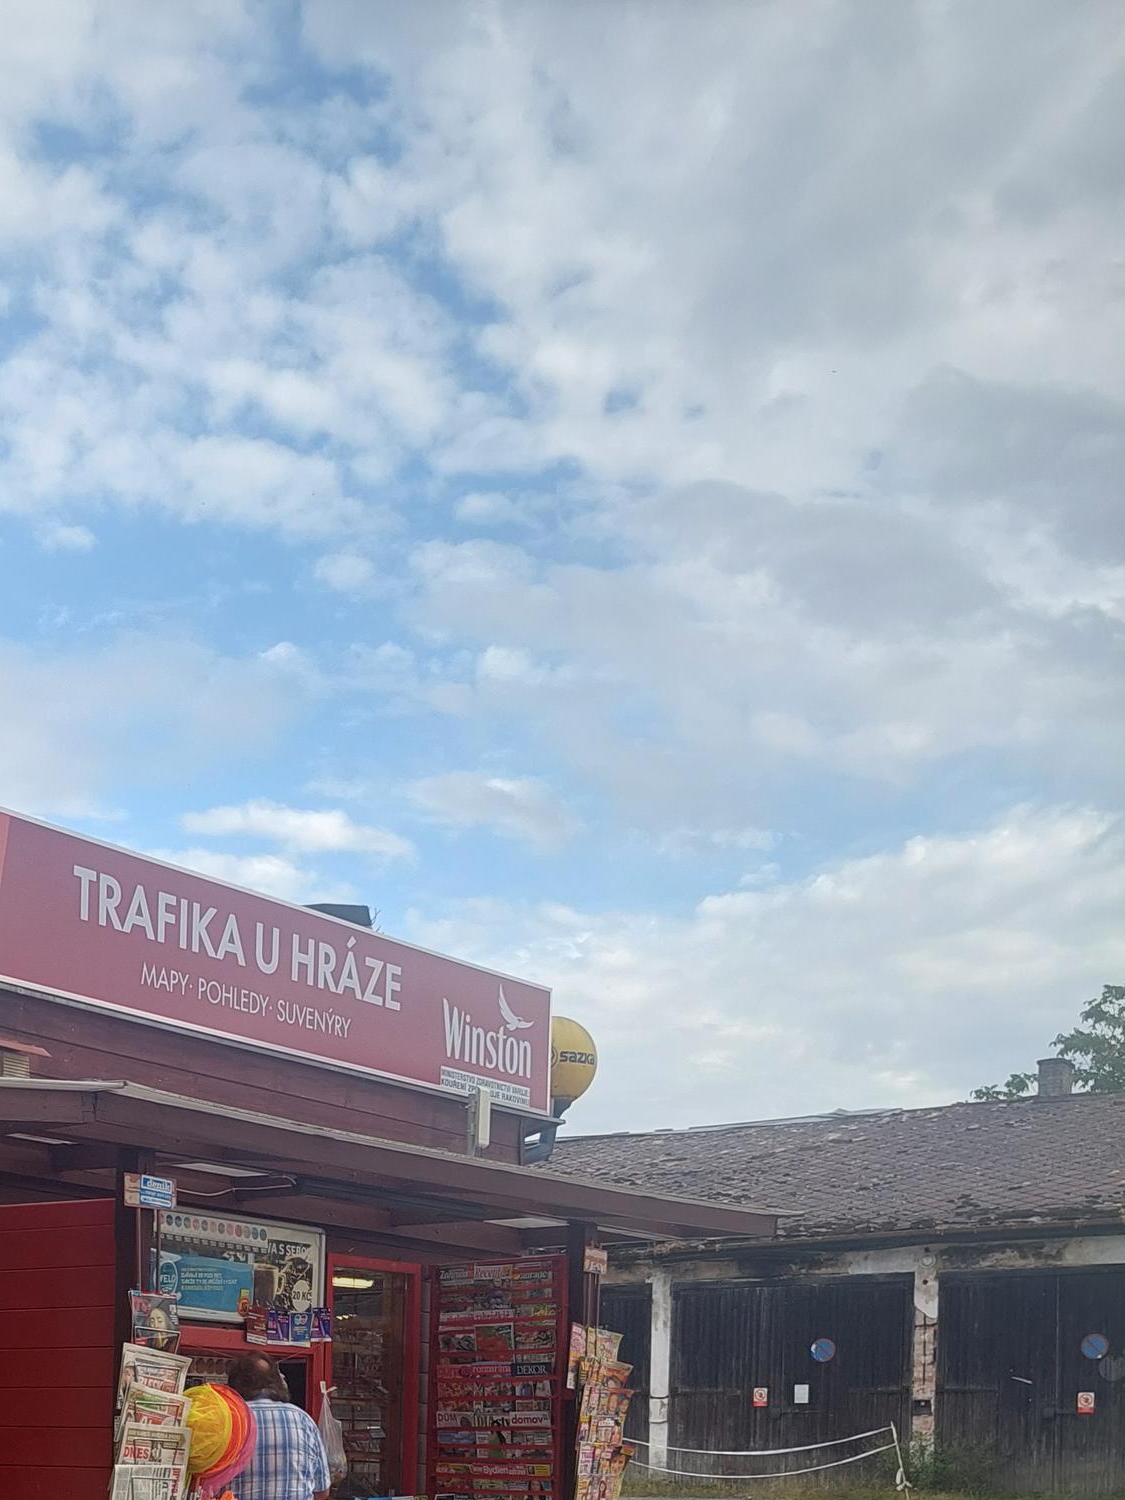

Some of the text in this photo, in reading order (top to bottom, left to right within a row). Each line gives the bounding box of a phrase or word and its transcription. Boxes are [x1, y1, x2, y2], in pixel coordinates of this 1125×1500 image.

[74, 865, 403, 1011] TRAFIKA U HRÁZE
[277, 999, 352, 1039] SUVENÝRY
[443, 997, 532, 1079] Winston
[516, 1365, 547, 1375] DEKOR
[123, 1446, 150, 1460] DNES
